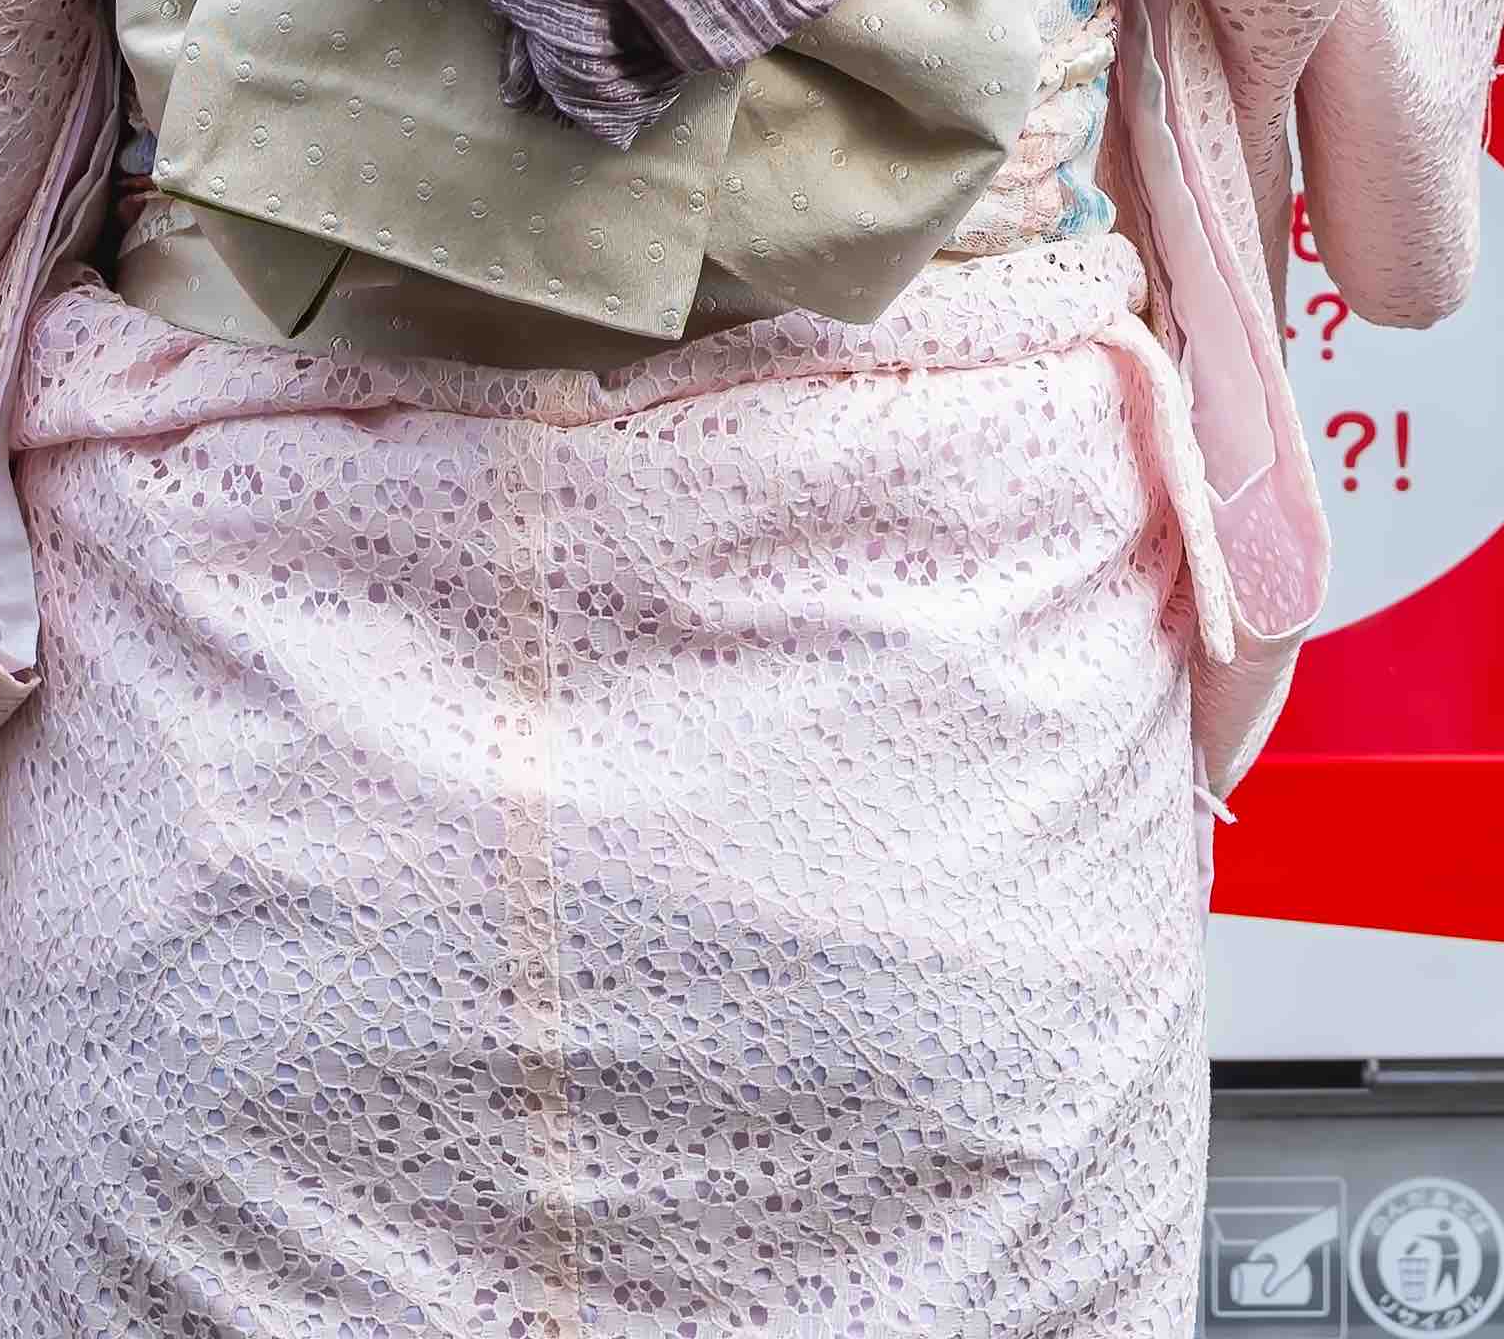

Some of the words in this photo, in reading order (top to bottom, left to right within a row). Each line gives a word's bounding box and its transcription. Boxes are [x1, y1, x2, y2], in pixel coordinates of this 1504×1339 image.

[1377, 1292, 1485, 1332] リサイクル
